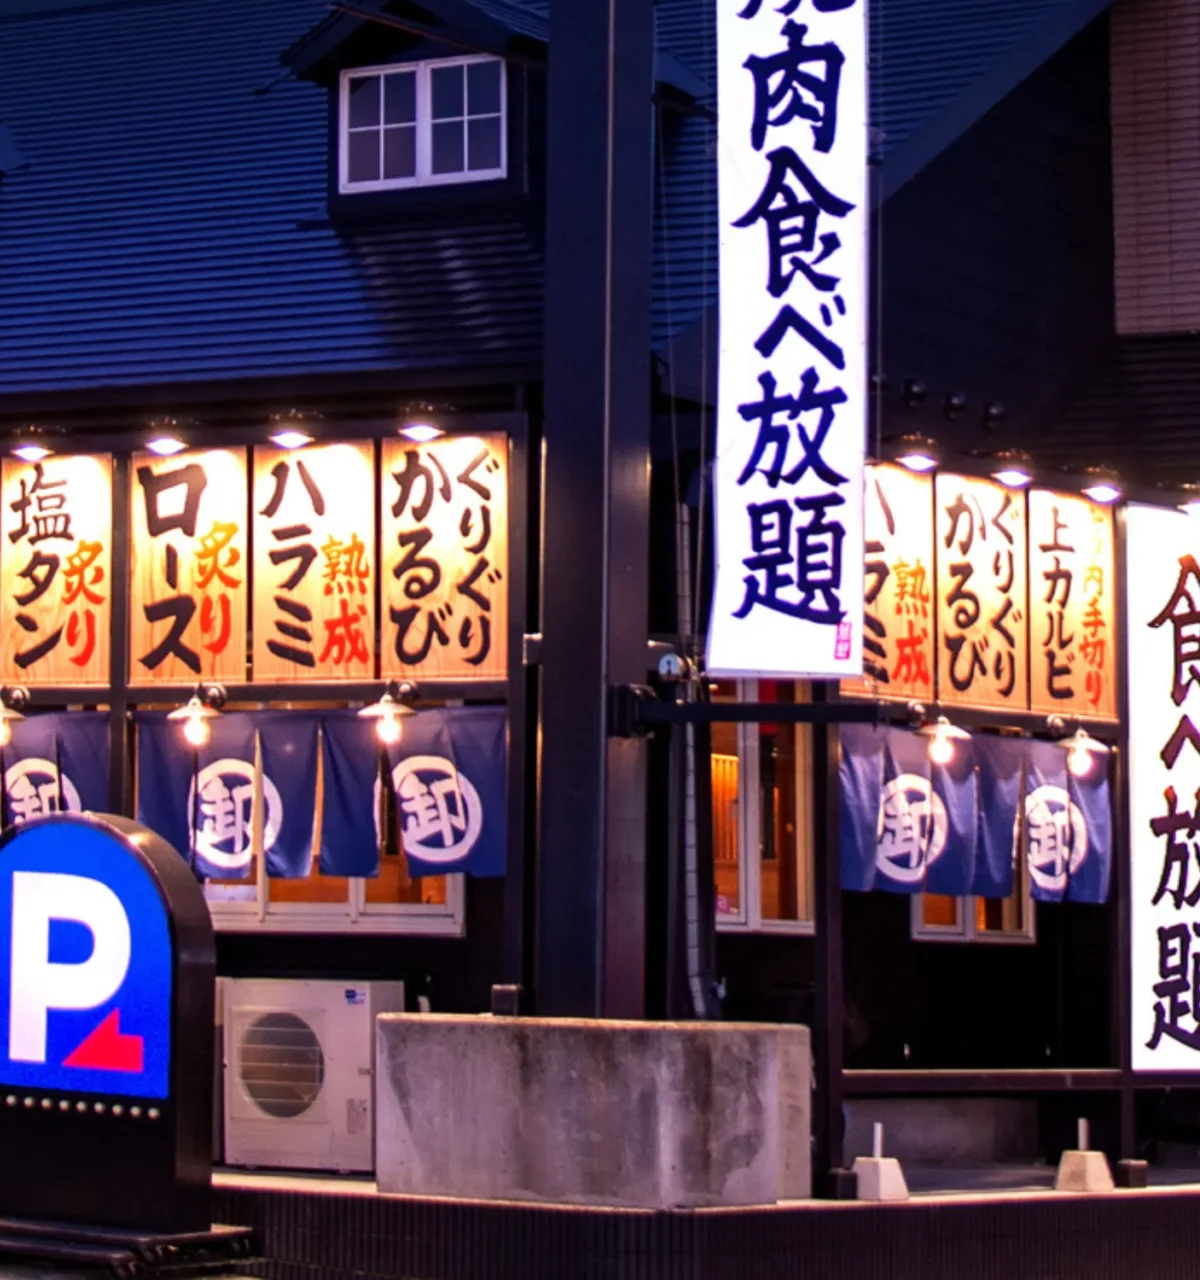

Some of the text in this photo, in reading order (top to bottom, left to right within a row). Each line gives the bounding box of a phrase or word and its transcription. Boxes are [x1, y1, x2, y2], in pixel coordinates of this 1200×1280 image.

[8, 463, 74, 669] 塩タン
[62, 540, 106, 668] 炙り
[137, 463, 207, 673] ロース
[194, 521, 242, 655] 炙り
[259, 460, 325, 668] ハラミ
[319, 533, 369, 666] 熟成
[389, 451, 453, 666] かるび
[456, 449, 502, 666] ぐりぐり
[892, 558, 930, 686] 熟成
[945, 492, 987, 692] かるび
[990, 491, 1022, 698] ぐりぐり
[1039, 506, 1076, 700] 上カルビ
[8, 871, 131, 1063] P
